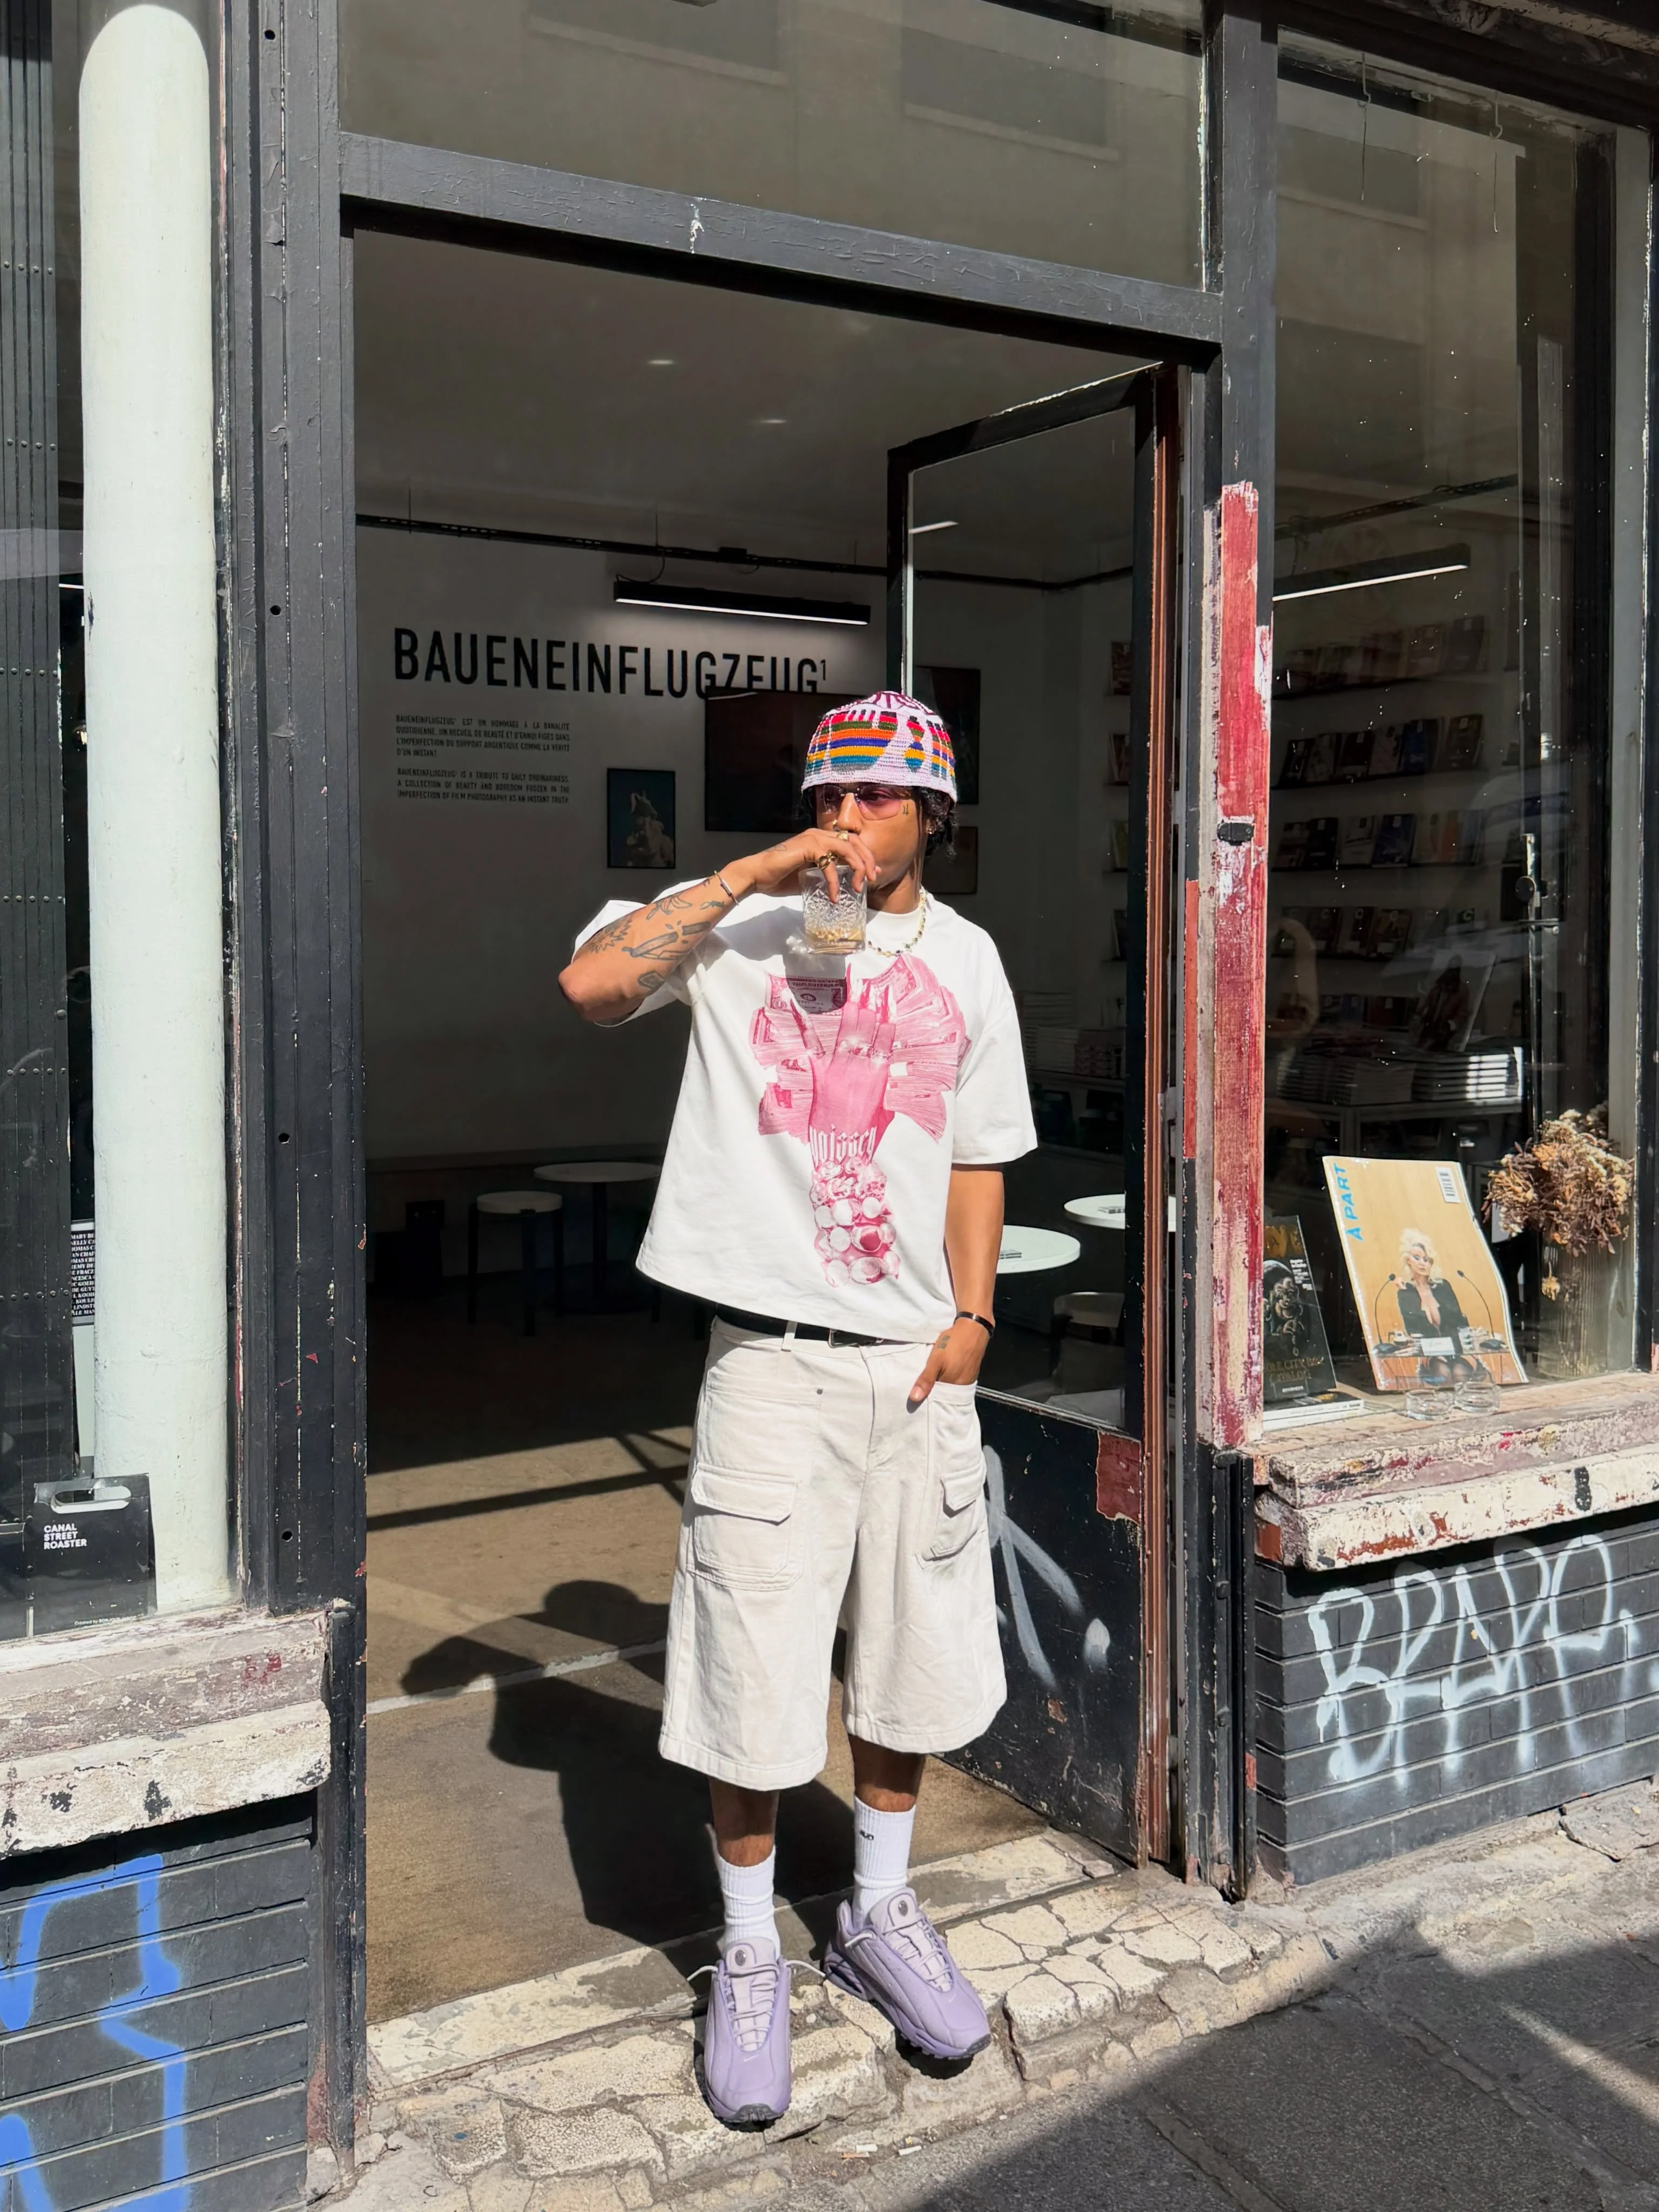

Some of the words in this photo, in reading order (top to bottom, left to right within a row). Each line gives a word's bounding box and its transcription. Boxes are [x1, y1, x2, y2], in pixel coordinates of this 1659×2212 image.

[449, 729, 472, 737] RECUEIL
[521, 743, 541, 751] COMME
[476, 772, 498, 780] TRIBUTE
[511, 773, 527, 781] DAILY
[405, 780, 441, 788] COLLECTION
[397, 790, 441, 799] IMPERFECTION
[468, 793, 507, 802] PHOTOGRAPHY
[1333, 1162, 1358, 1220] PART
[44, 1523, 77, 1533] CANAL
[44, 1531, 78, 1541] STREET
[44, 1539, 87, 1550] ROASTER
